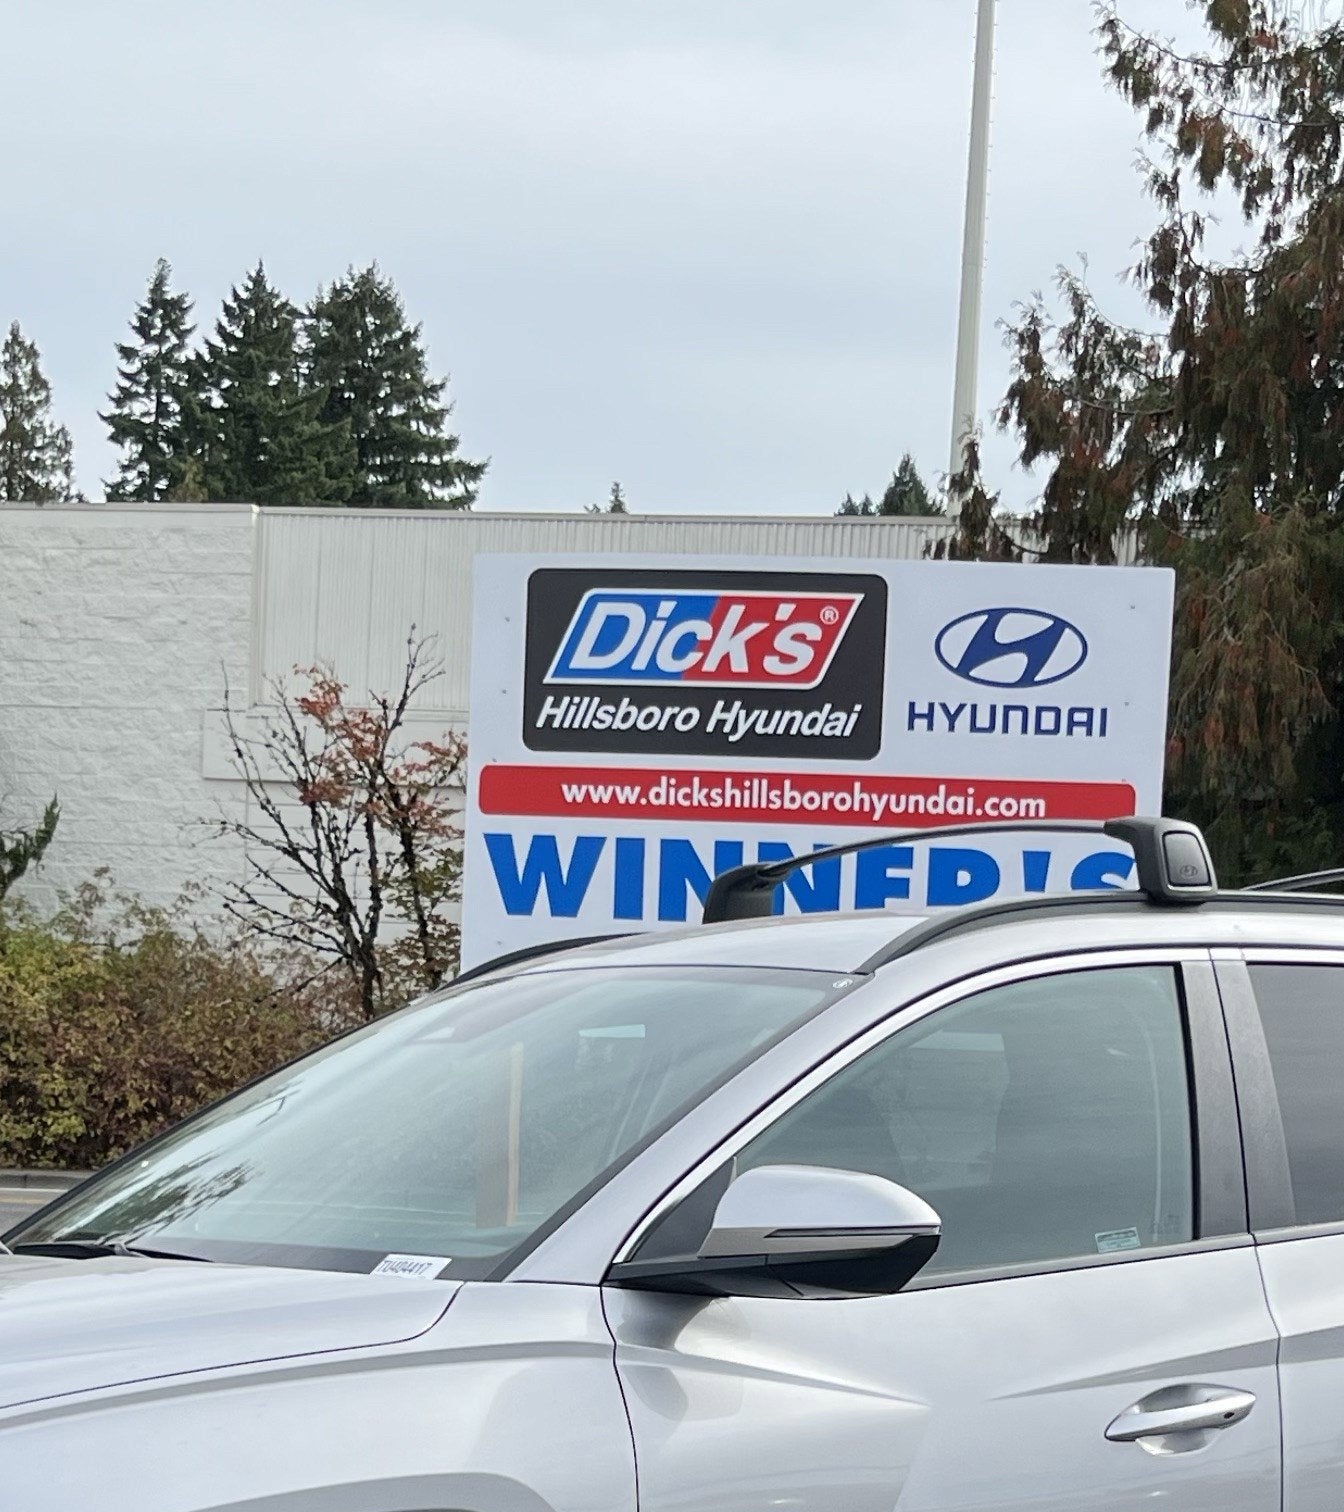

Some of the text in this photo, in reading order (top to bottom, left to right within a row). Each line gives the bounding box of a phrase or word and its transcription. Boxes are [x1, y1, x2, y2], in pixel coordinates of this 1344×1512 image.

[536, 696, 862, 742] Hillsboro Hyundai
[908, 701, 1108, 738] HYUNDAI
[561, 775, 1046, 821] www.dickshillsborohyundai.com
